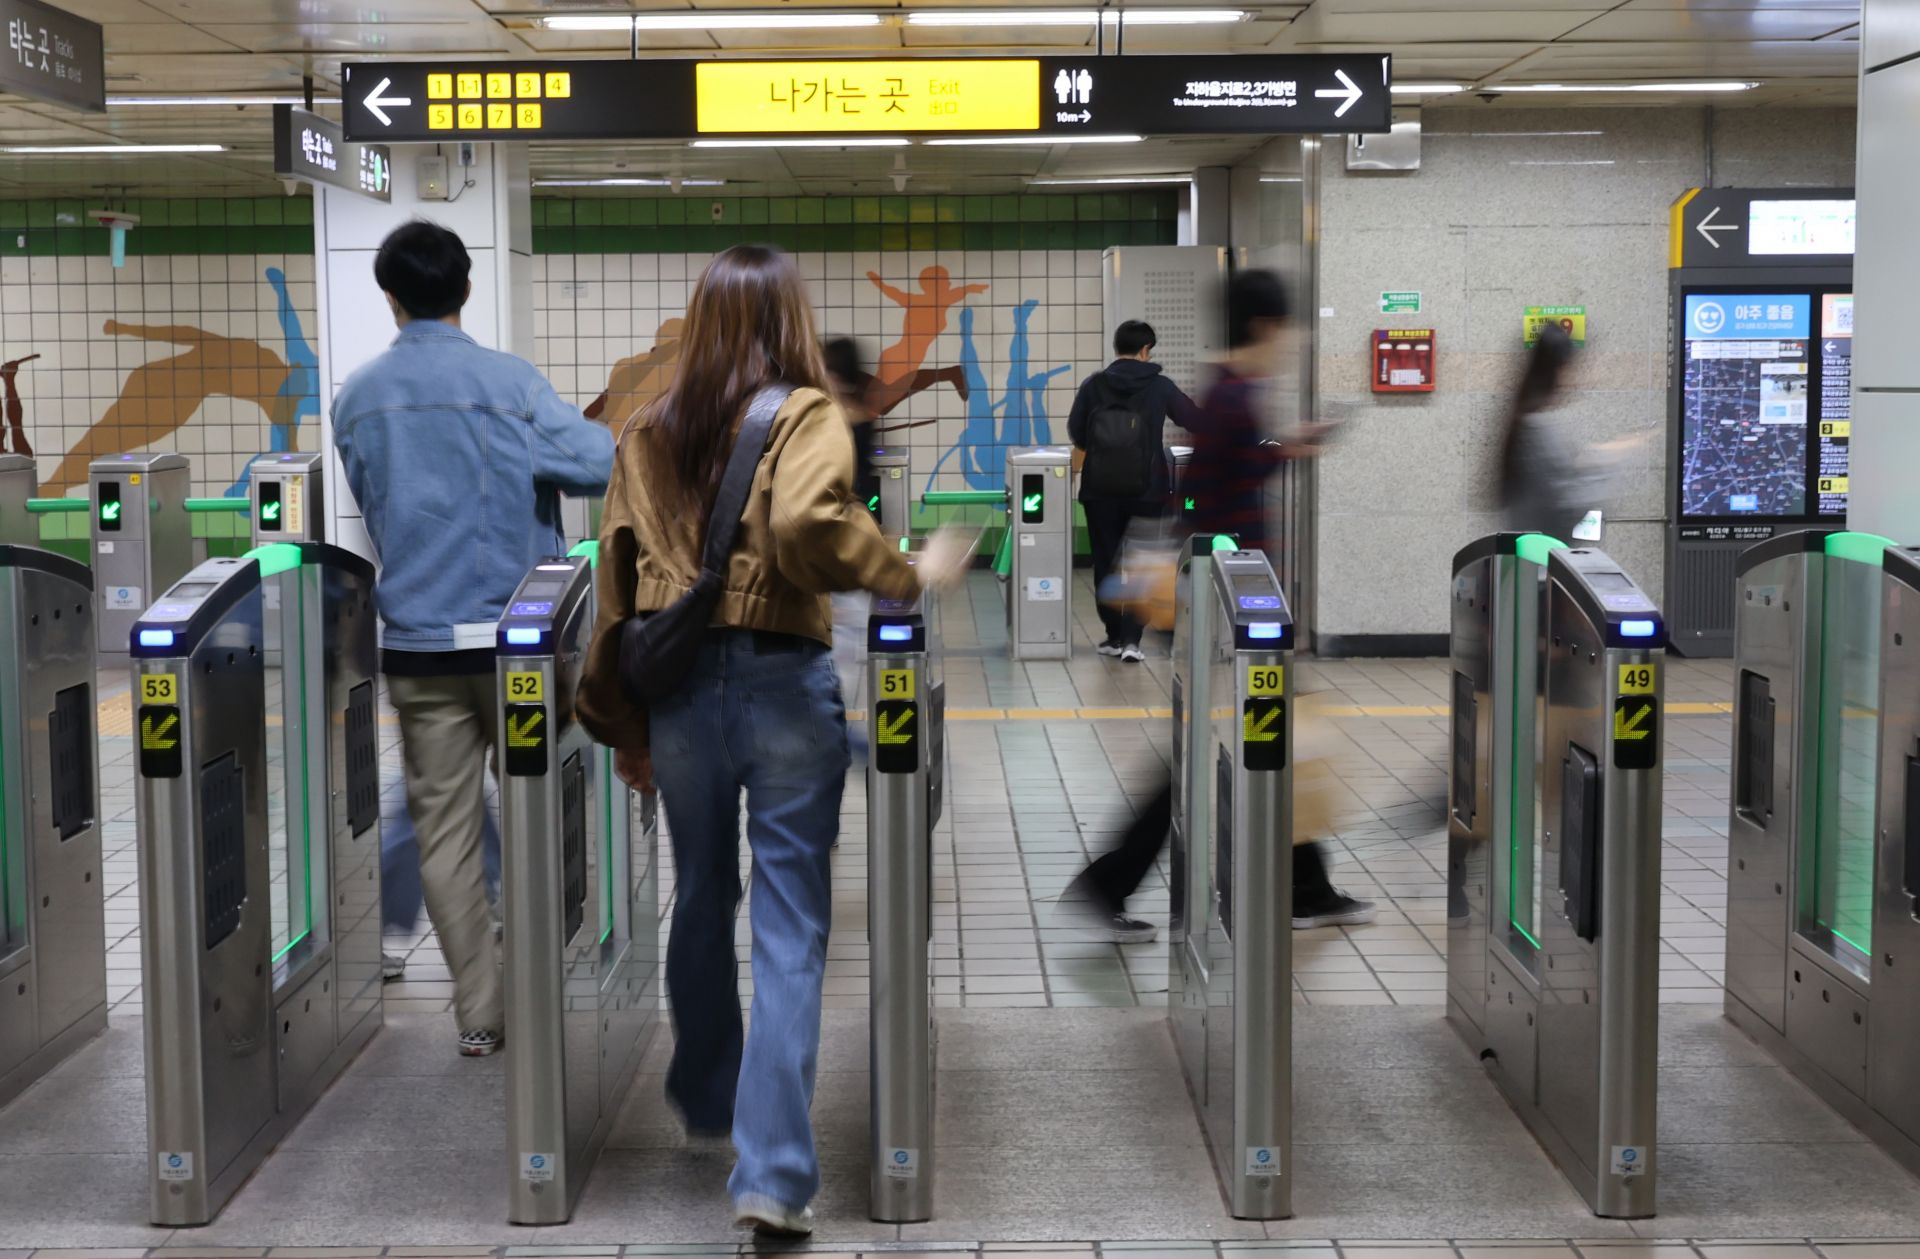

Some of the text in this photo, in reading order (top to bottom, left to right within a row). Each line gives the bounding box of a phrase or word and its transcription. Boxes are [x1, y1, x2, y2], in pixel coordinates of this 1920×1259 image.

[9, 17, 50, 73] 타는 곳
[54, 34, 74, 60] Tracks
[436, 78, 561, 94] 1 1-1 2 3 4
[928, 80, 961, 96] Exit
[770, 77, 910, 114] 나가는 곳
[436, 109, 534, 124] 5 6 7 8
[929, 101, 959, 115] 出口
[1056, 111, 1079, 123] 10m
[1735, 304, 1794, 321] 아주 좋음
[1823, 424, 1831, 434] 3
[1822, 481, 1830, 490] 4
[512, 677, 537, 695] 52
[884, 674, 909, 693] 51
[1253, 671, 1278, 690] 50
[1624, 669, 1650, 688] 49
[146, 679, 171, 698] 53
